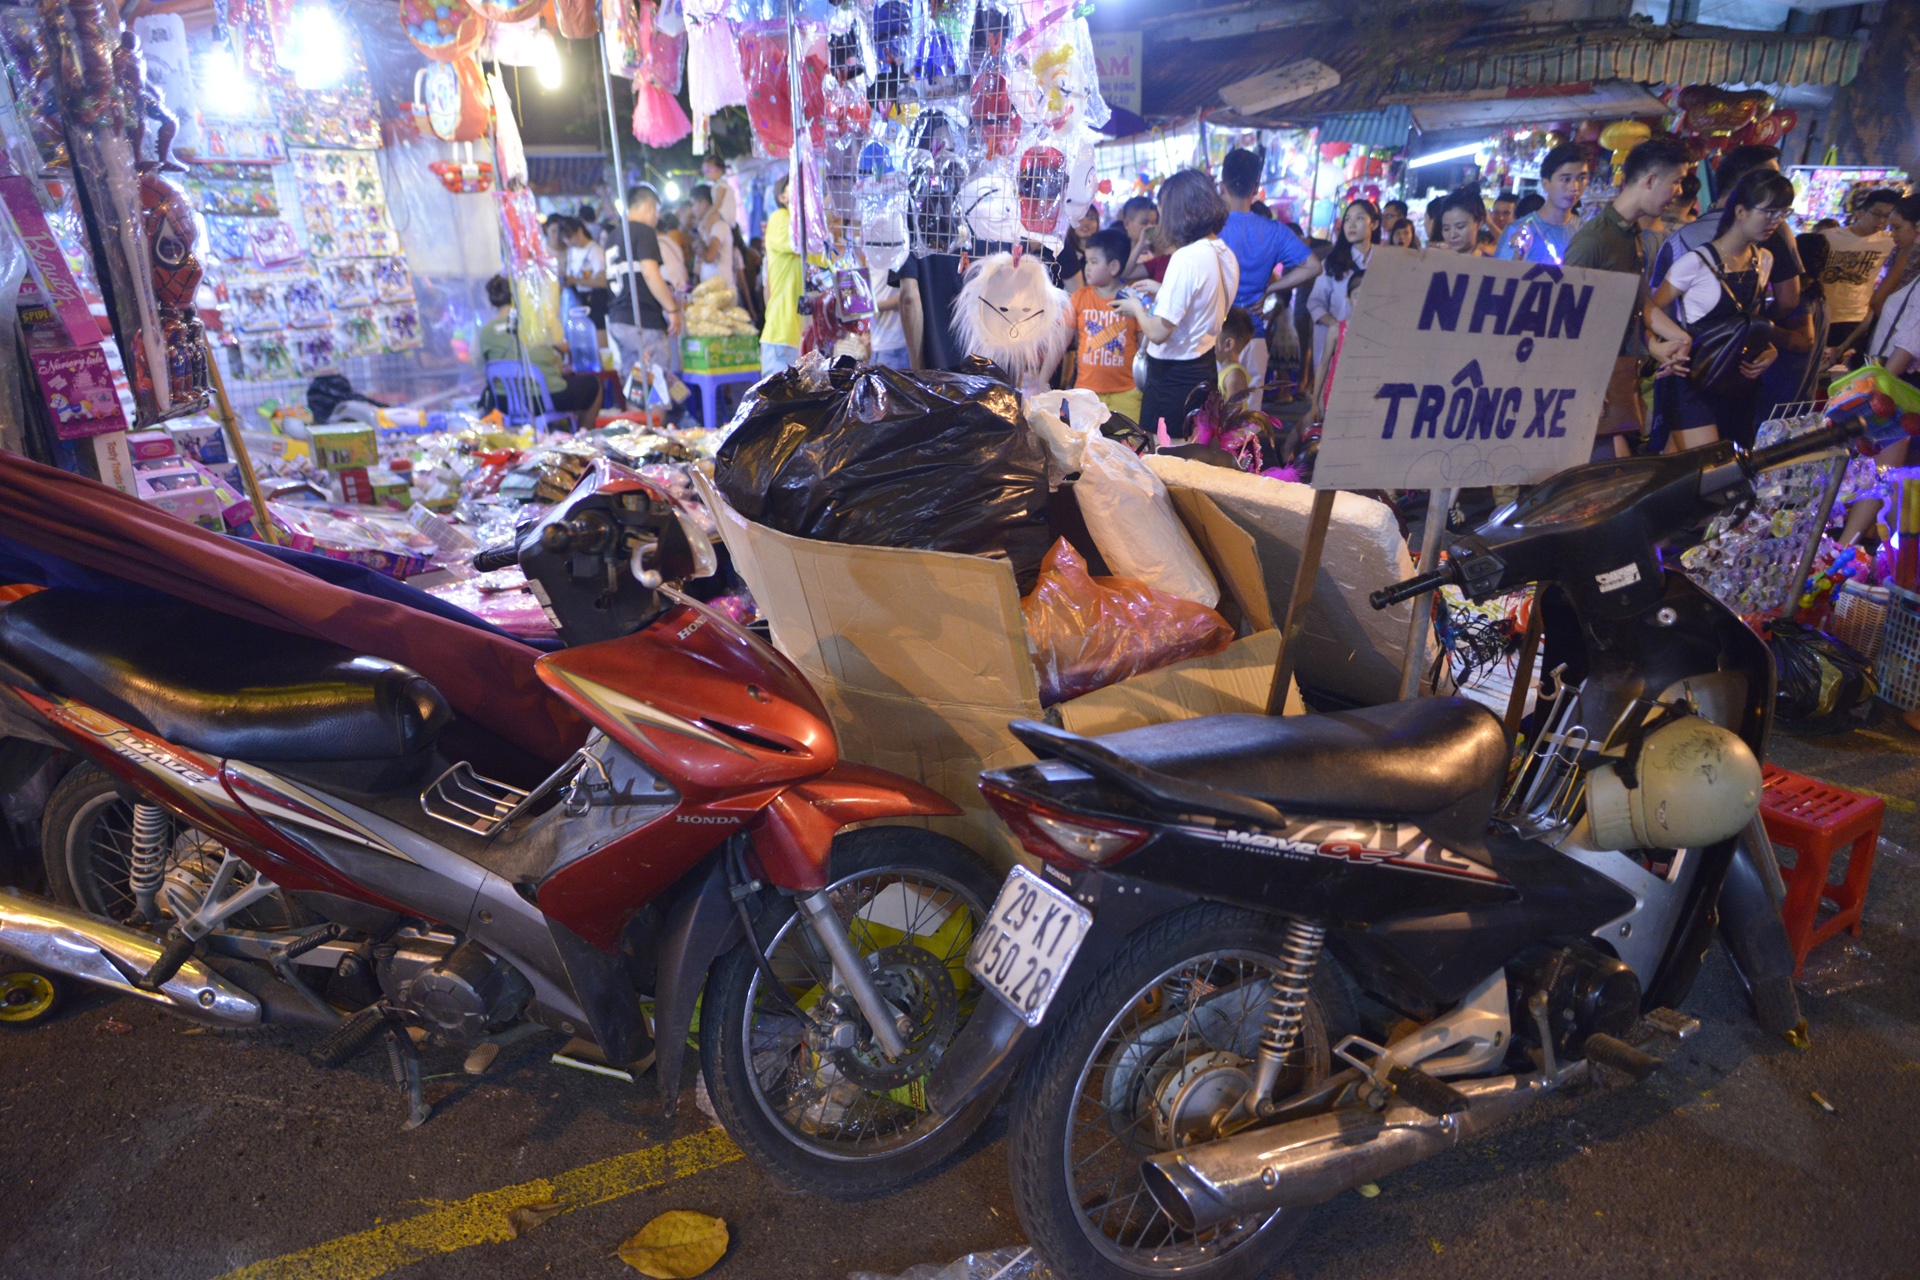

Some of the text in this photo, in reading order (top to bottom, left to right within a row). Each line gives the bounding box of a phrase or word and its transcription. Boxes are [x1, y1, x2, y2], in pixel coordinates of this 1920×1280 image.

[23, 231, 83, 304] Beauty
[1417, 263, 1595, 363] NHẬN
[38, 351, 104, 375] Nursery tale
[1374, 358, 1577, 441] TRÔNG XE
[107, 441, 118, 464] Tasty
[676, 814, 741, 825] HONDA
[1045, 863, 1073, 887] HONDA
[1001, 882, 1073, 958] 29-K1
[973, 923, 1051, 1012] 050.28
